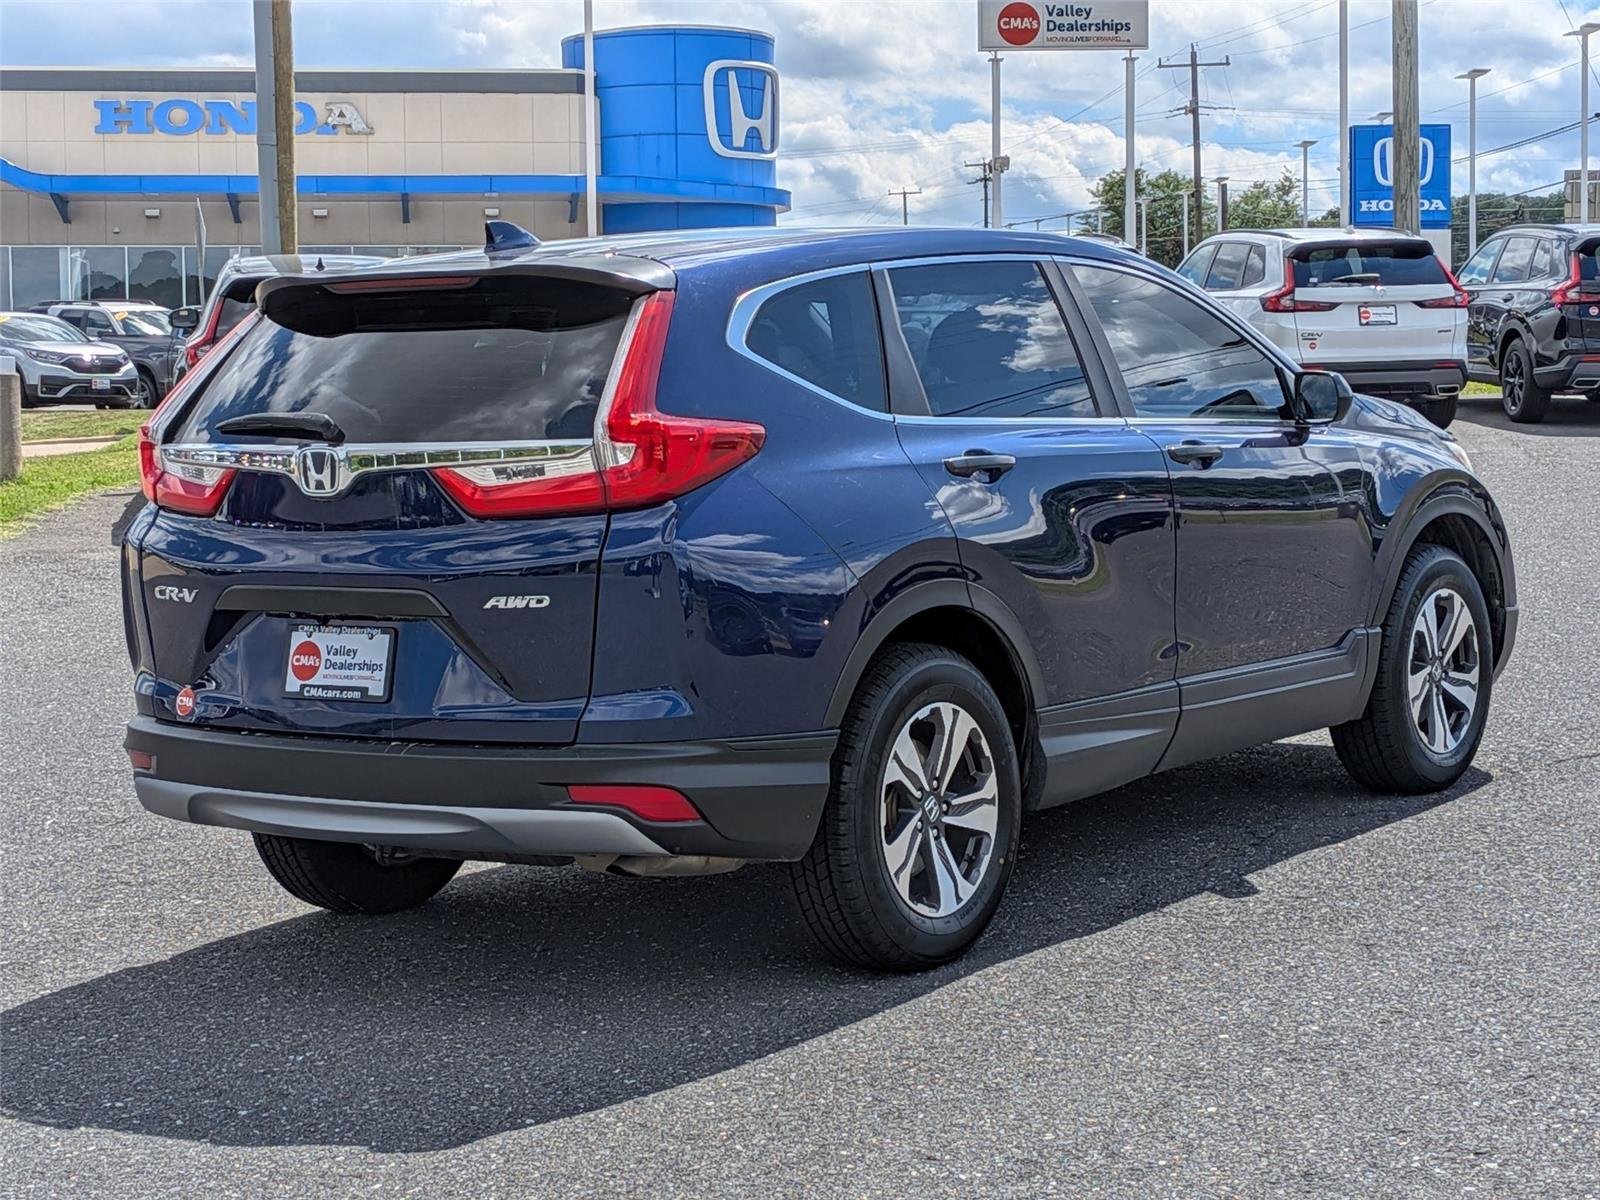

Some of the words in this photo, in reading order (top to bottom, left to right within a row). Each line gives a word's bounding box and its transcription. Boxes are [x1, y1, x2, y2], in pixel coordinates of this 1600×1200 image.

[1045, 4, 1092, 20] Valley
[1000, 17, 1039, 29] CMA's
[1046, 19, 1131, 35] Dealerships
[1360, 199, 1447, 211] HODA
[154, 585, 199, 603] CR-V
[482, 595, 551, 609] AWD
[298, 625, 319, 633] CMA's
[320, 626, 341, 635] Valley
[326, 644, 358, 659] Valley
[293, 655, 320, 667] CMA's
[324, 658, 383, 674] Dealerships
[303, 687, 362, 698] CMAcars.com
